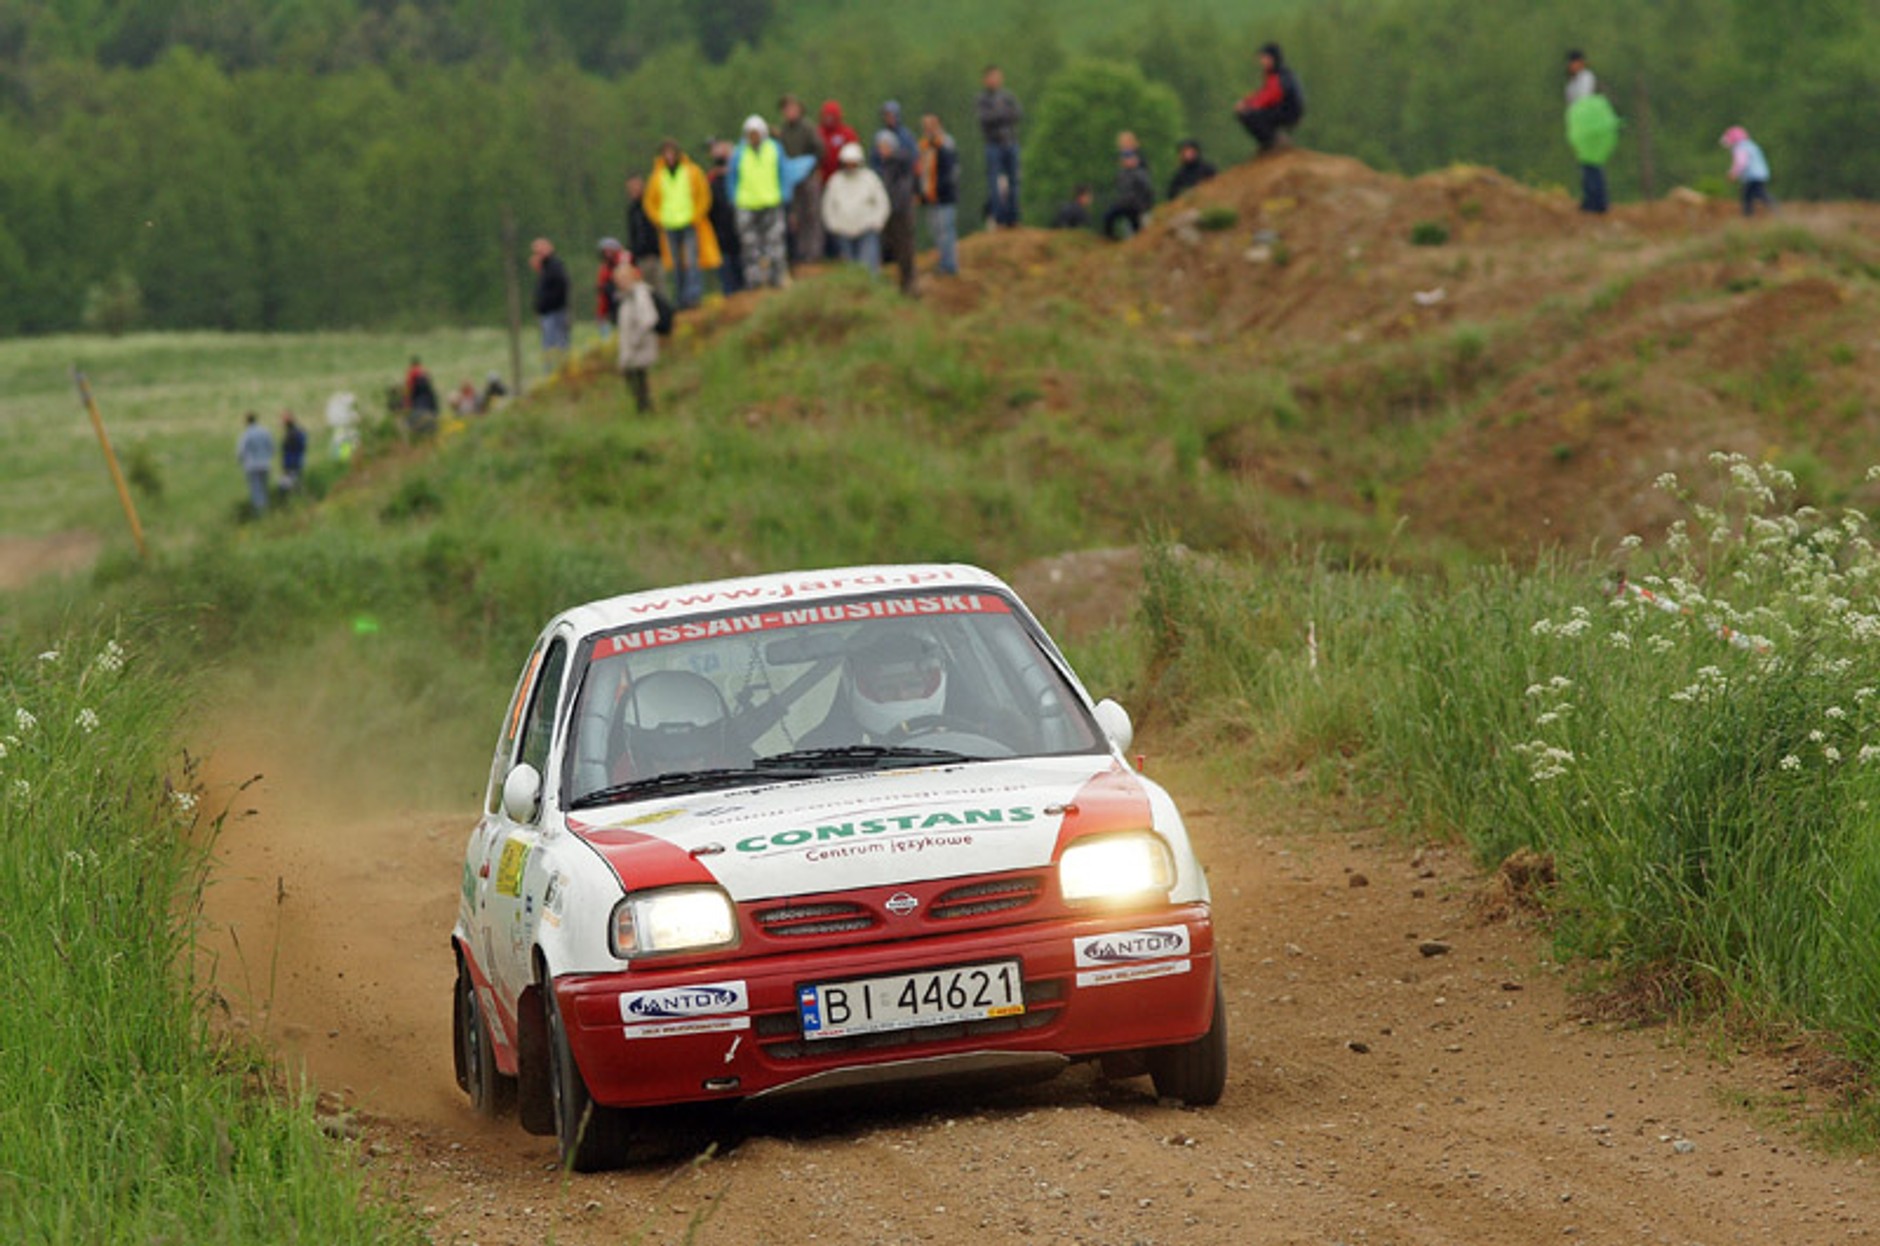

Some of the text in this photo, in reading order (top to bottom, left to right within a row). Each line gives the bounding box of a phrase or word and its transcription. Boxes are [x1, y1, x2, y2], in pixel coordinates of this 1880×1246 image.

[612, 594, 983, 651] NISSAN-MUSINSKI
[735, 806, 1035, 852] CONSTANS
[805, 833, 973, 862] Centrum językowe
[824, 984, 872, 1024] BI
[898, 965, 1012, 1014] 44621
